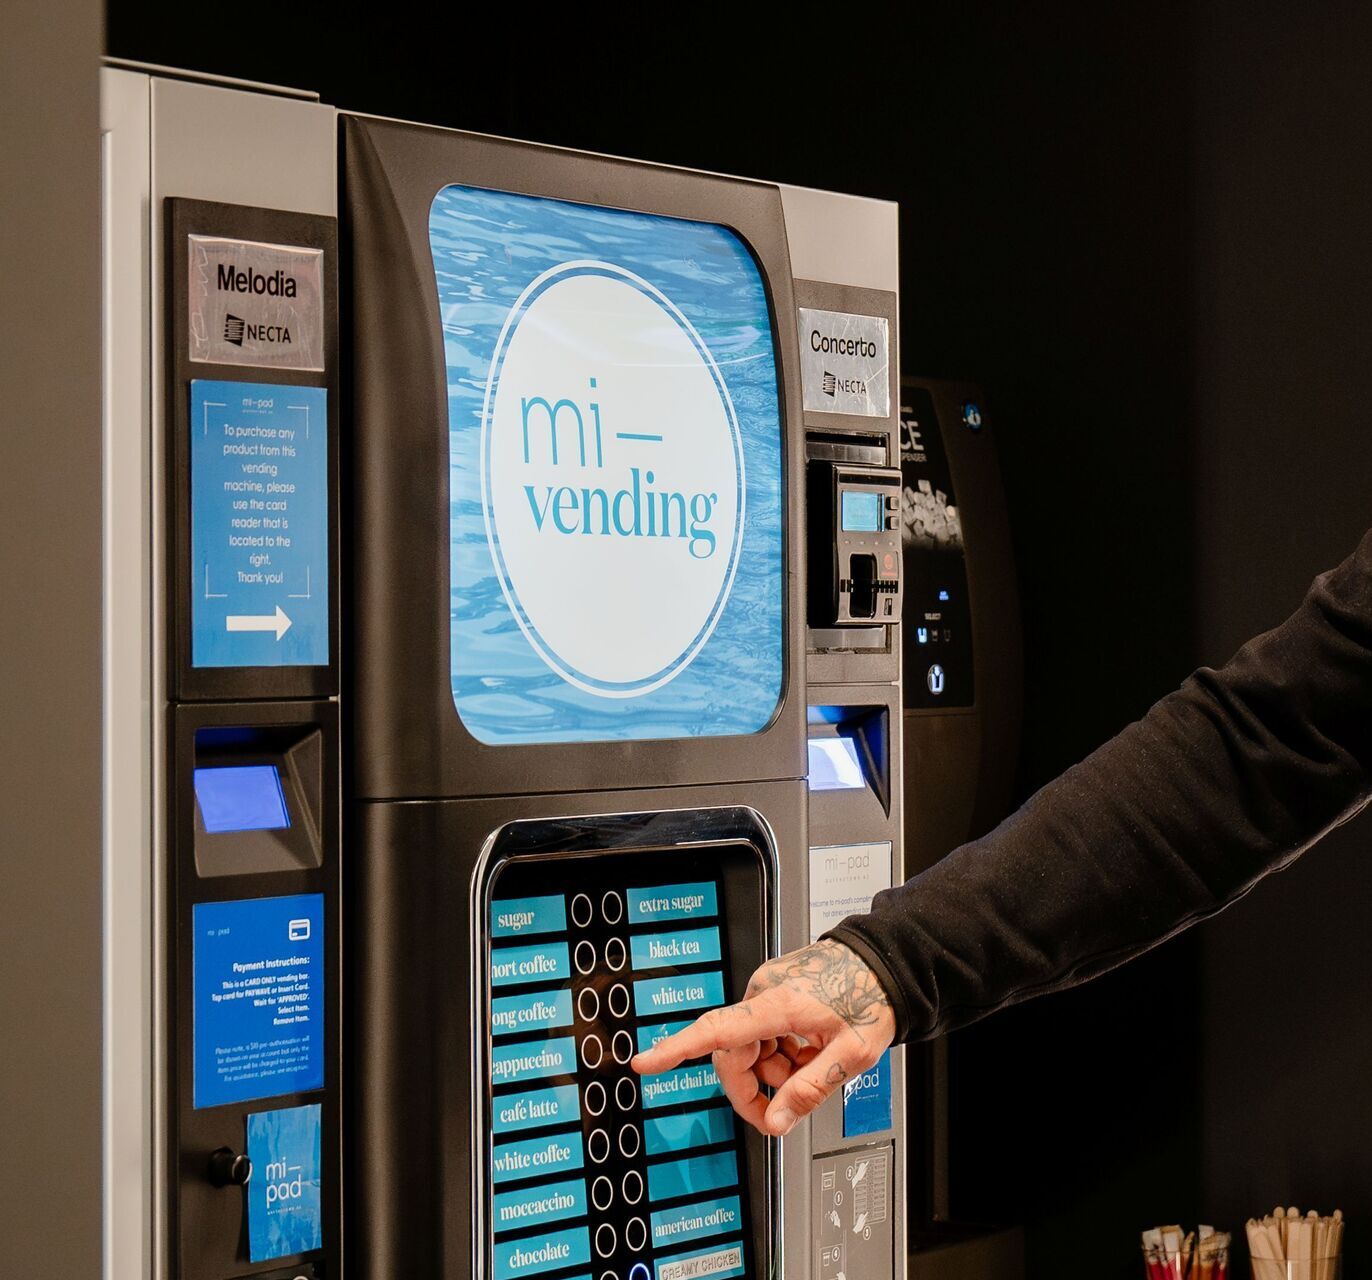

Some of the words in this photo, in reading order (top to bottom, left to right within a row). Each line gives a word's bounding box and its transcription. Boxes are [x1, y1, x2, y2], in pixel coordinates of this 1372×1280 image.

[217, 264, 297, 298] Melodia
[247, 324, 292, 344] NECTA
[810, 330, 877, 358] Concerto
[838, 379, 866, 394] NECTA
[224, 424, 235, 436] To
[236, 426, 277, 438] purchase
[278, 431, 295, 441] any
[223, 444, 258, 457] product
[259, 444, 280, 456] from
[282, 445, 296, 457] this
[241, 463, 278, 477] vending
[224, 481, 265, 494] machine,
[266, 482, 296, 494] please
[233, 500, 247, 510] use
[250, 499, 264, 510] the
[266, 500, 287, 511] card
[522, 468, 718, 559] vending
[231, 517, 261, 529] reader
[263, 518, 281, 529] that
[282, 518, 289, 529] is
[229, 535, 264, 547] located
[265, 536, 275, 547] to
[276, 536, 291, 547] the
[237, 571, 263, 583] Thank
[264, 572, 283, 585] you!
[639, 897, 670, 913] extra
[671, 894, 704, 913] sugar
[498, 910, 535, 930] sugar
[649, 939, 680, 959] black
[682, 937, 700, 955] tea
[233, 960, 264, 973] Payment
[266, 956, 310, 968] Instructions:
[519, 954, 557, 976] coffee
[222, 981, 234, 989] This
[245, 978, 261, 987] CARD
[261, 976, 276, 985] ONLY
[277, 974, 298, 982] vending
[212, 994, 222, 1003] Tap
[222, 992, 235, 1000] card
[278, 985, 294, 993] Insert
[253, 999, 267, 1007] Wait
[268, 997, 276, 1005] for
[651, 987, 684, 1006] white
[686, 983, 704, 1001] tea
[278, 1006, 295, 1014] Select
[492, 1009, 517, 1029] ong
[518, 1001, 557, 1023] coffee
[273, 1017, 294, 1025] Remove
[643, 1074, 678, 1100] spiced
[680, 1071, 702, 1090] chai
[855, 1067, 880, 1095] pad
[500, 1099, 527, 1123] café
[528, 1099, 559, 1119] latte
[494, 1148, 530, 1173] white
[532, 1143, 571, 1165] coffee
[266, 1173, 302, 1209] pad
[500, 1192, 575, 1220] moccaccino
[655, 1216, 703, 1237] american
[704, 1208, 735, 1227] coffee
[509, 1242, 570, 1269] chocolate
[701, 1251, 740, 1272] CHICKEN
